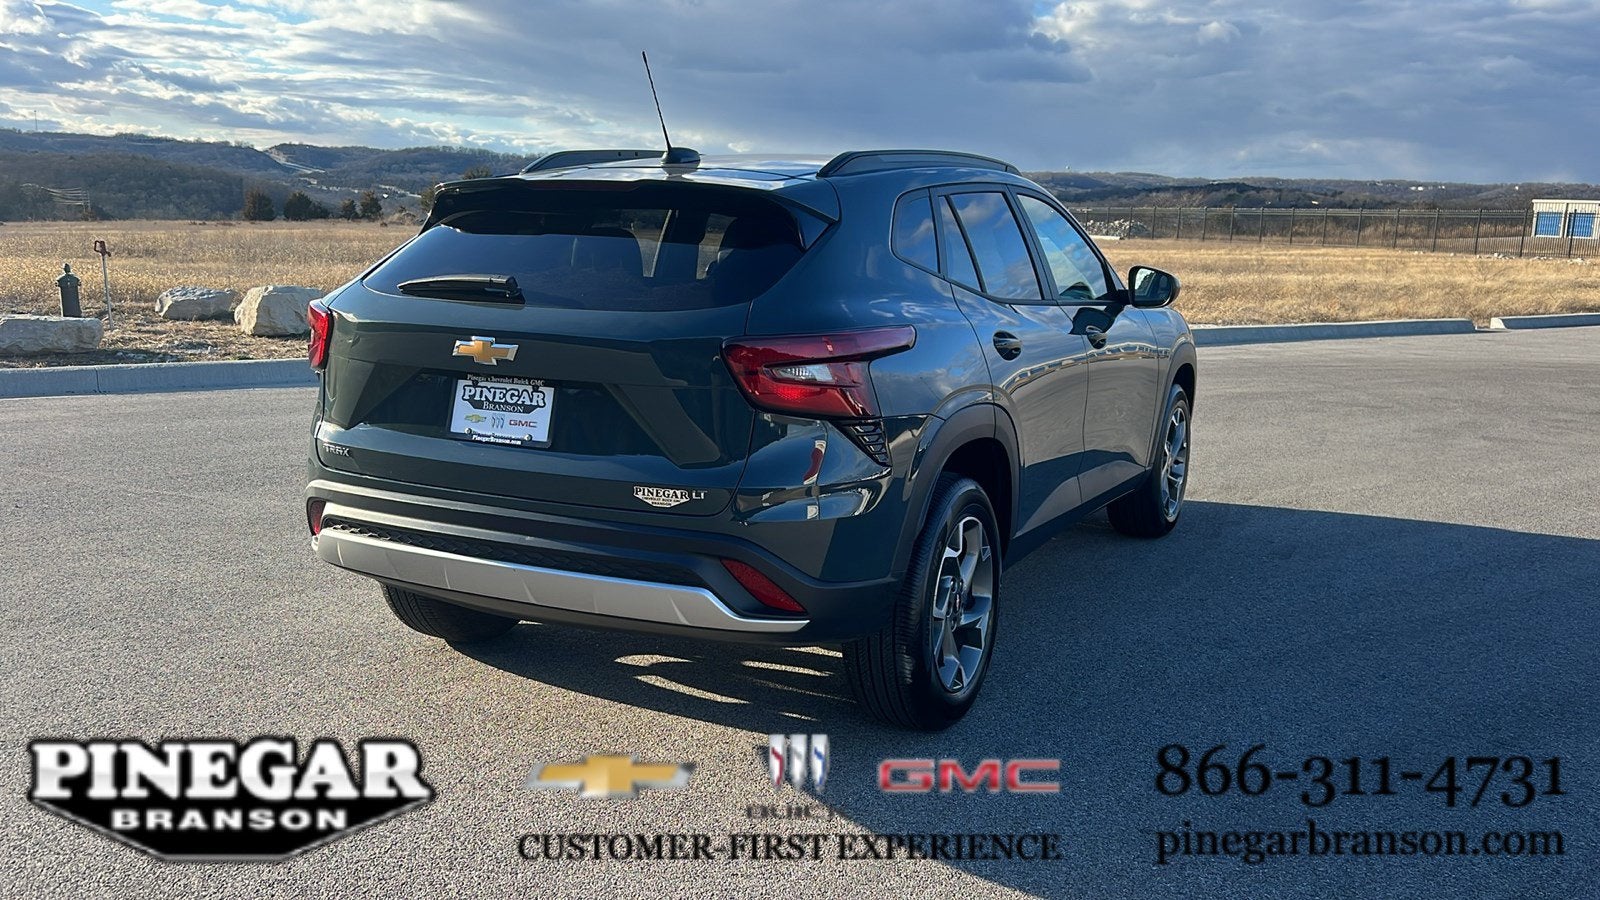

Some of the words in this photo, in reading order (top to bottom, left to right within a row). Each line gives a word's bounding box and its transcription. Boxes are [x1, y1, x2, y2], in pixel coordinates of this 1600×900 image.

[530, 379, 545, 387] GMC
[462, 385, 546, 408] PINEGAR
[482, 401, 525, 413] BRANSON
[508, 419, 538, 428] GMC
[323, 443, 350, 457] TRAX
[634, 486, 690, 500] PINEGAR
[692, 490, 708, 499] LT
